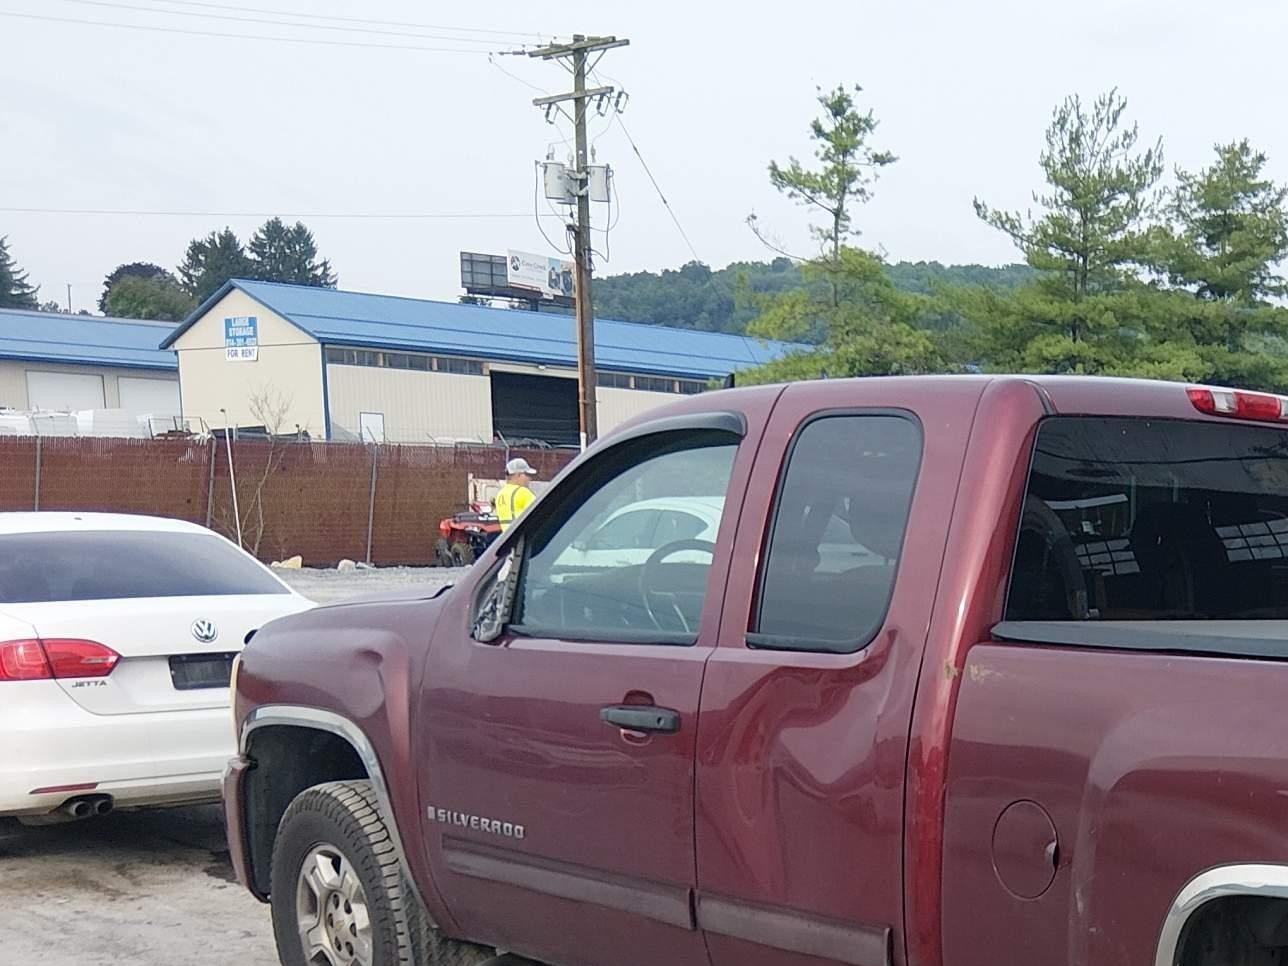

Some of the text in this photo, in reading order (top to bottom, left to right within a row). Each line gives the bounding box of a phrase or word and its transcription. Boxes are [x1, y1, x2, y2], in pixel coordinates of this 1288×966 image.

[227, 348, 255, 358] FOR RENT
[71, 680, 108, 688] JETTA
[437, 808, 525, 839] SILVERADO
